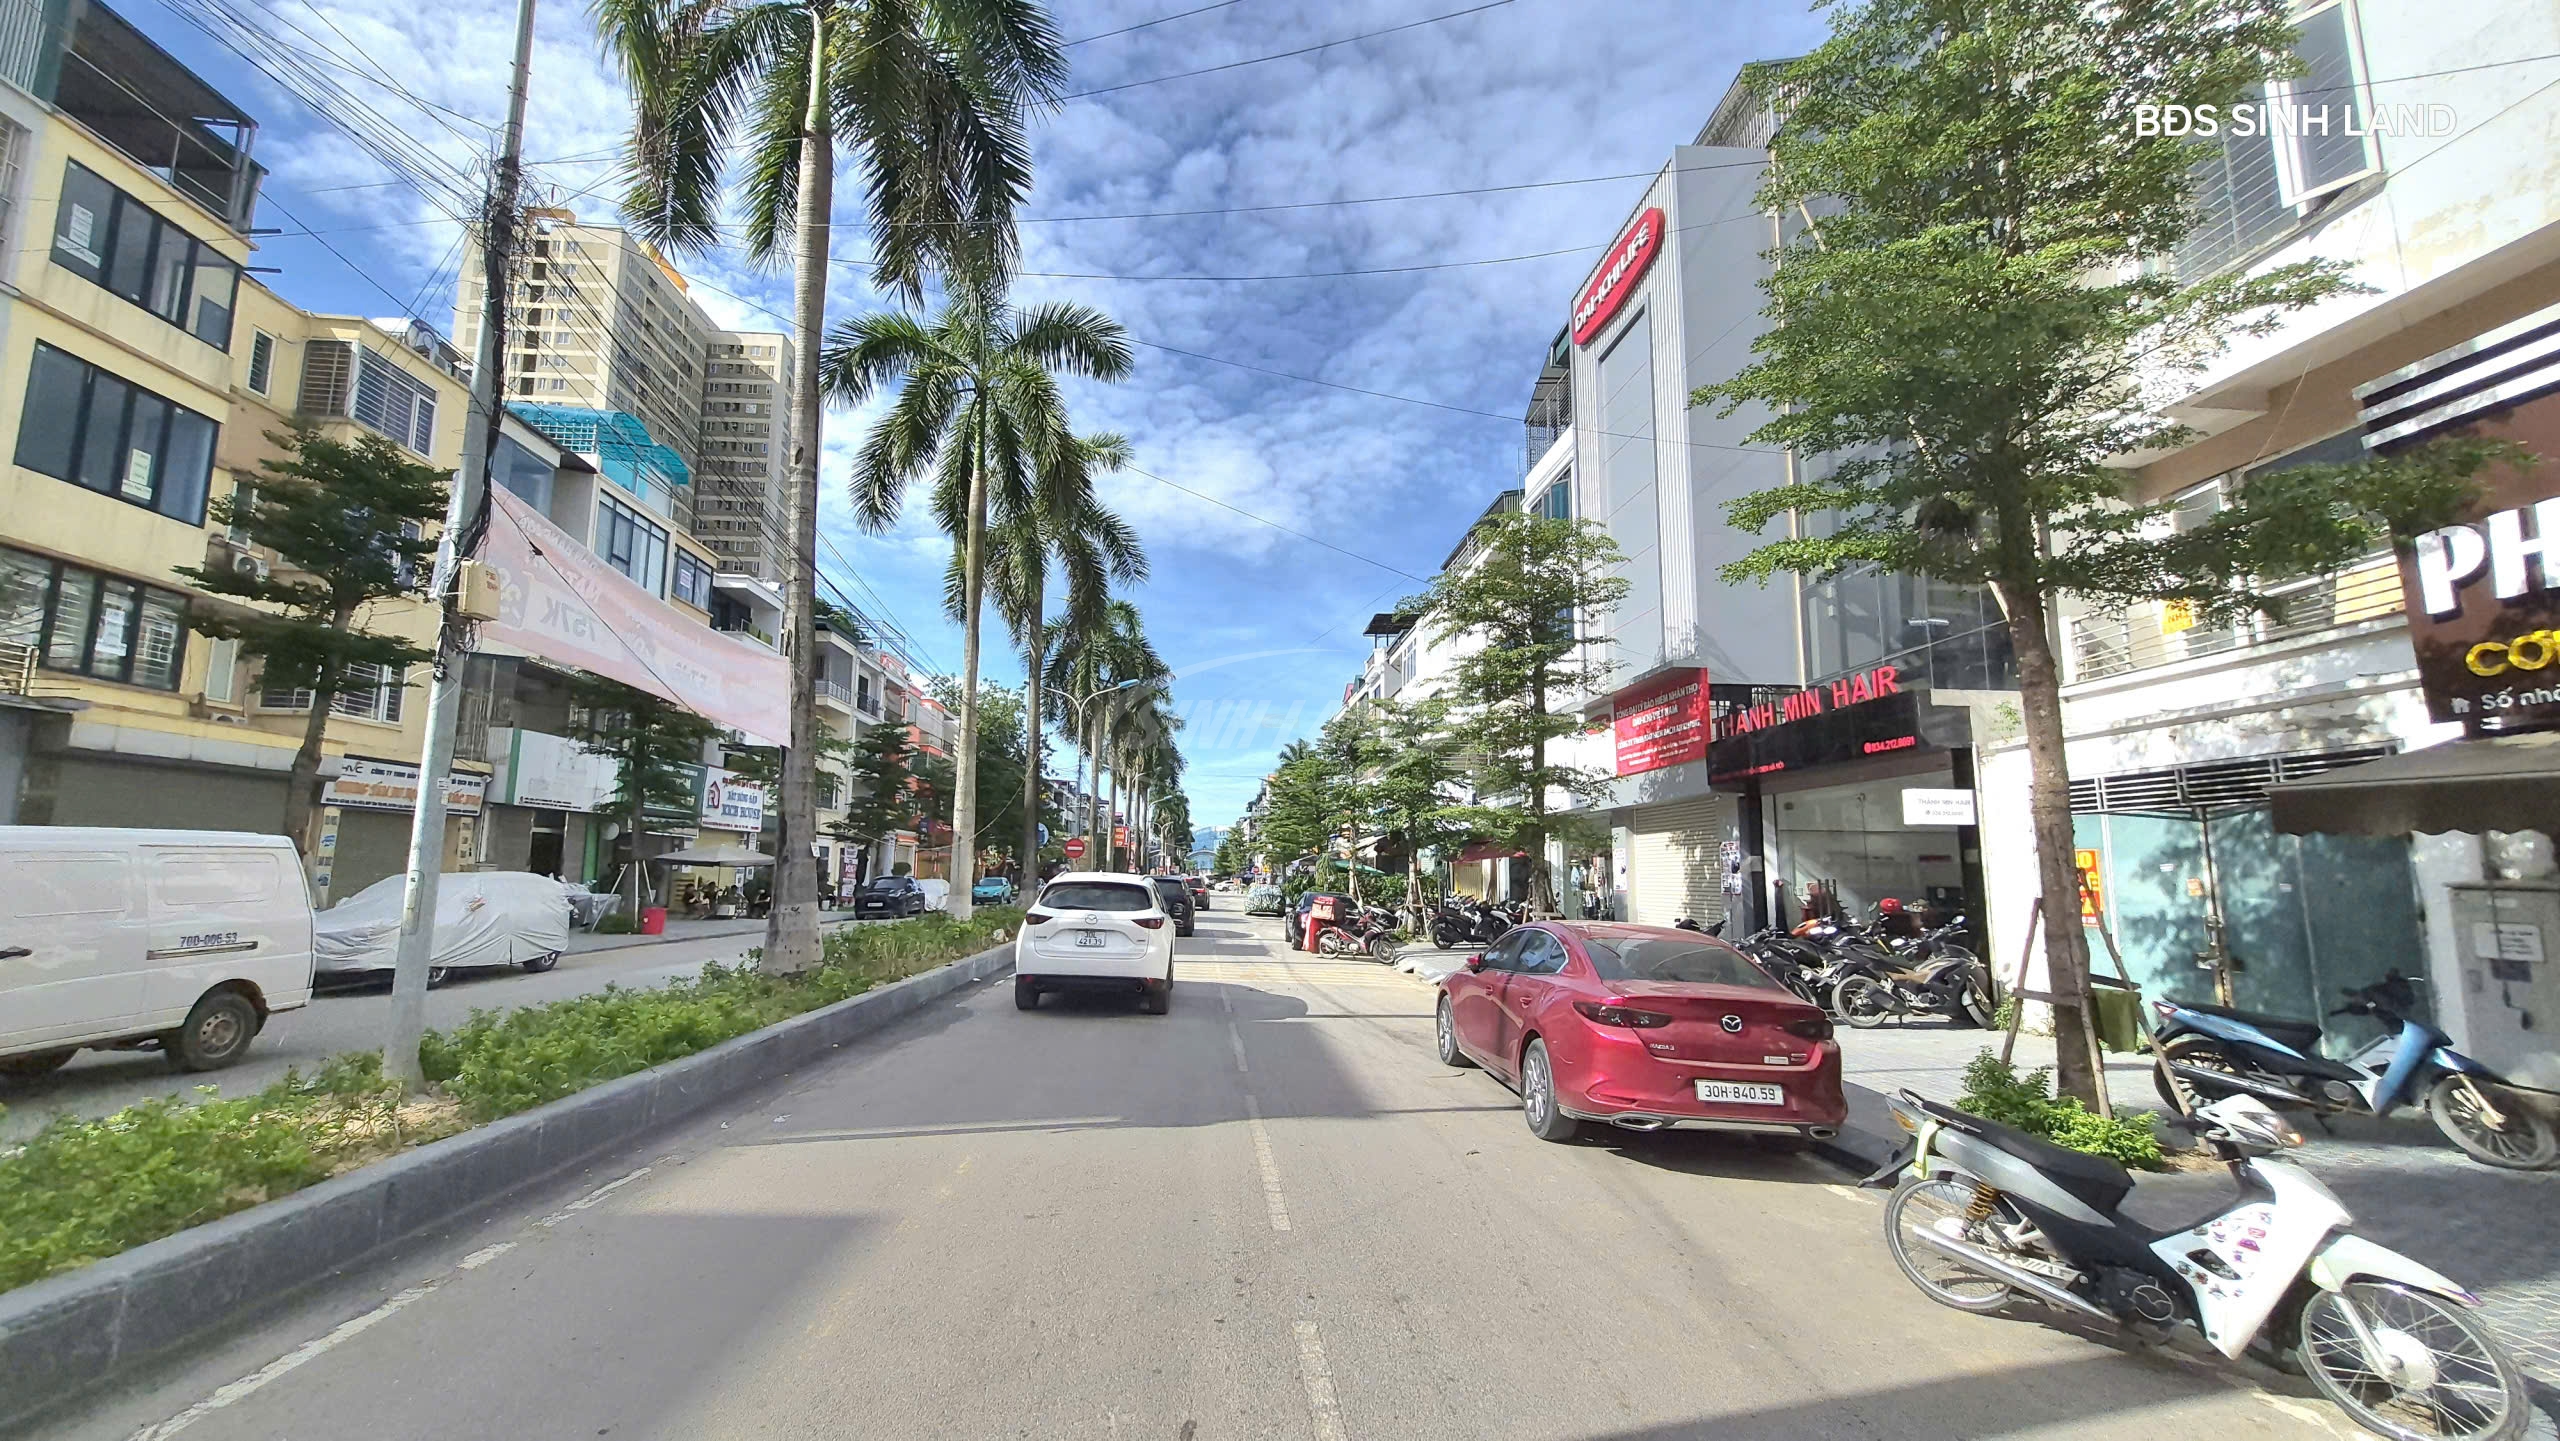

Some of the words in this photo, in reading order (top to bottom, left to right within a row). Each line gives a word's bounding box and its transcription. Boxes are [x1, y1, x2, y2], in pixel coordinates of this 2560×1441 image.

[1783, 687, 1822, 722] MIN
[1831, 665, 1899, 709] HAIR
[2481, 686, 2514, 710] Số
[1704, 1085, 1776, 1100] 30H-840.59
